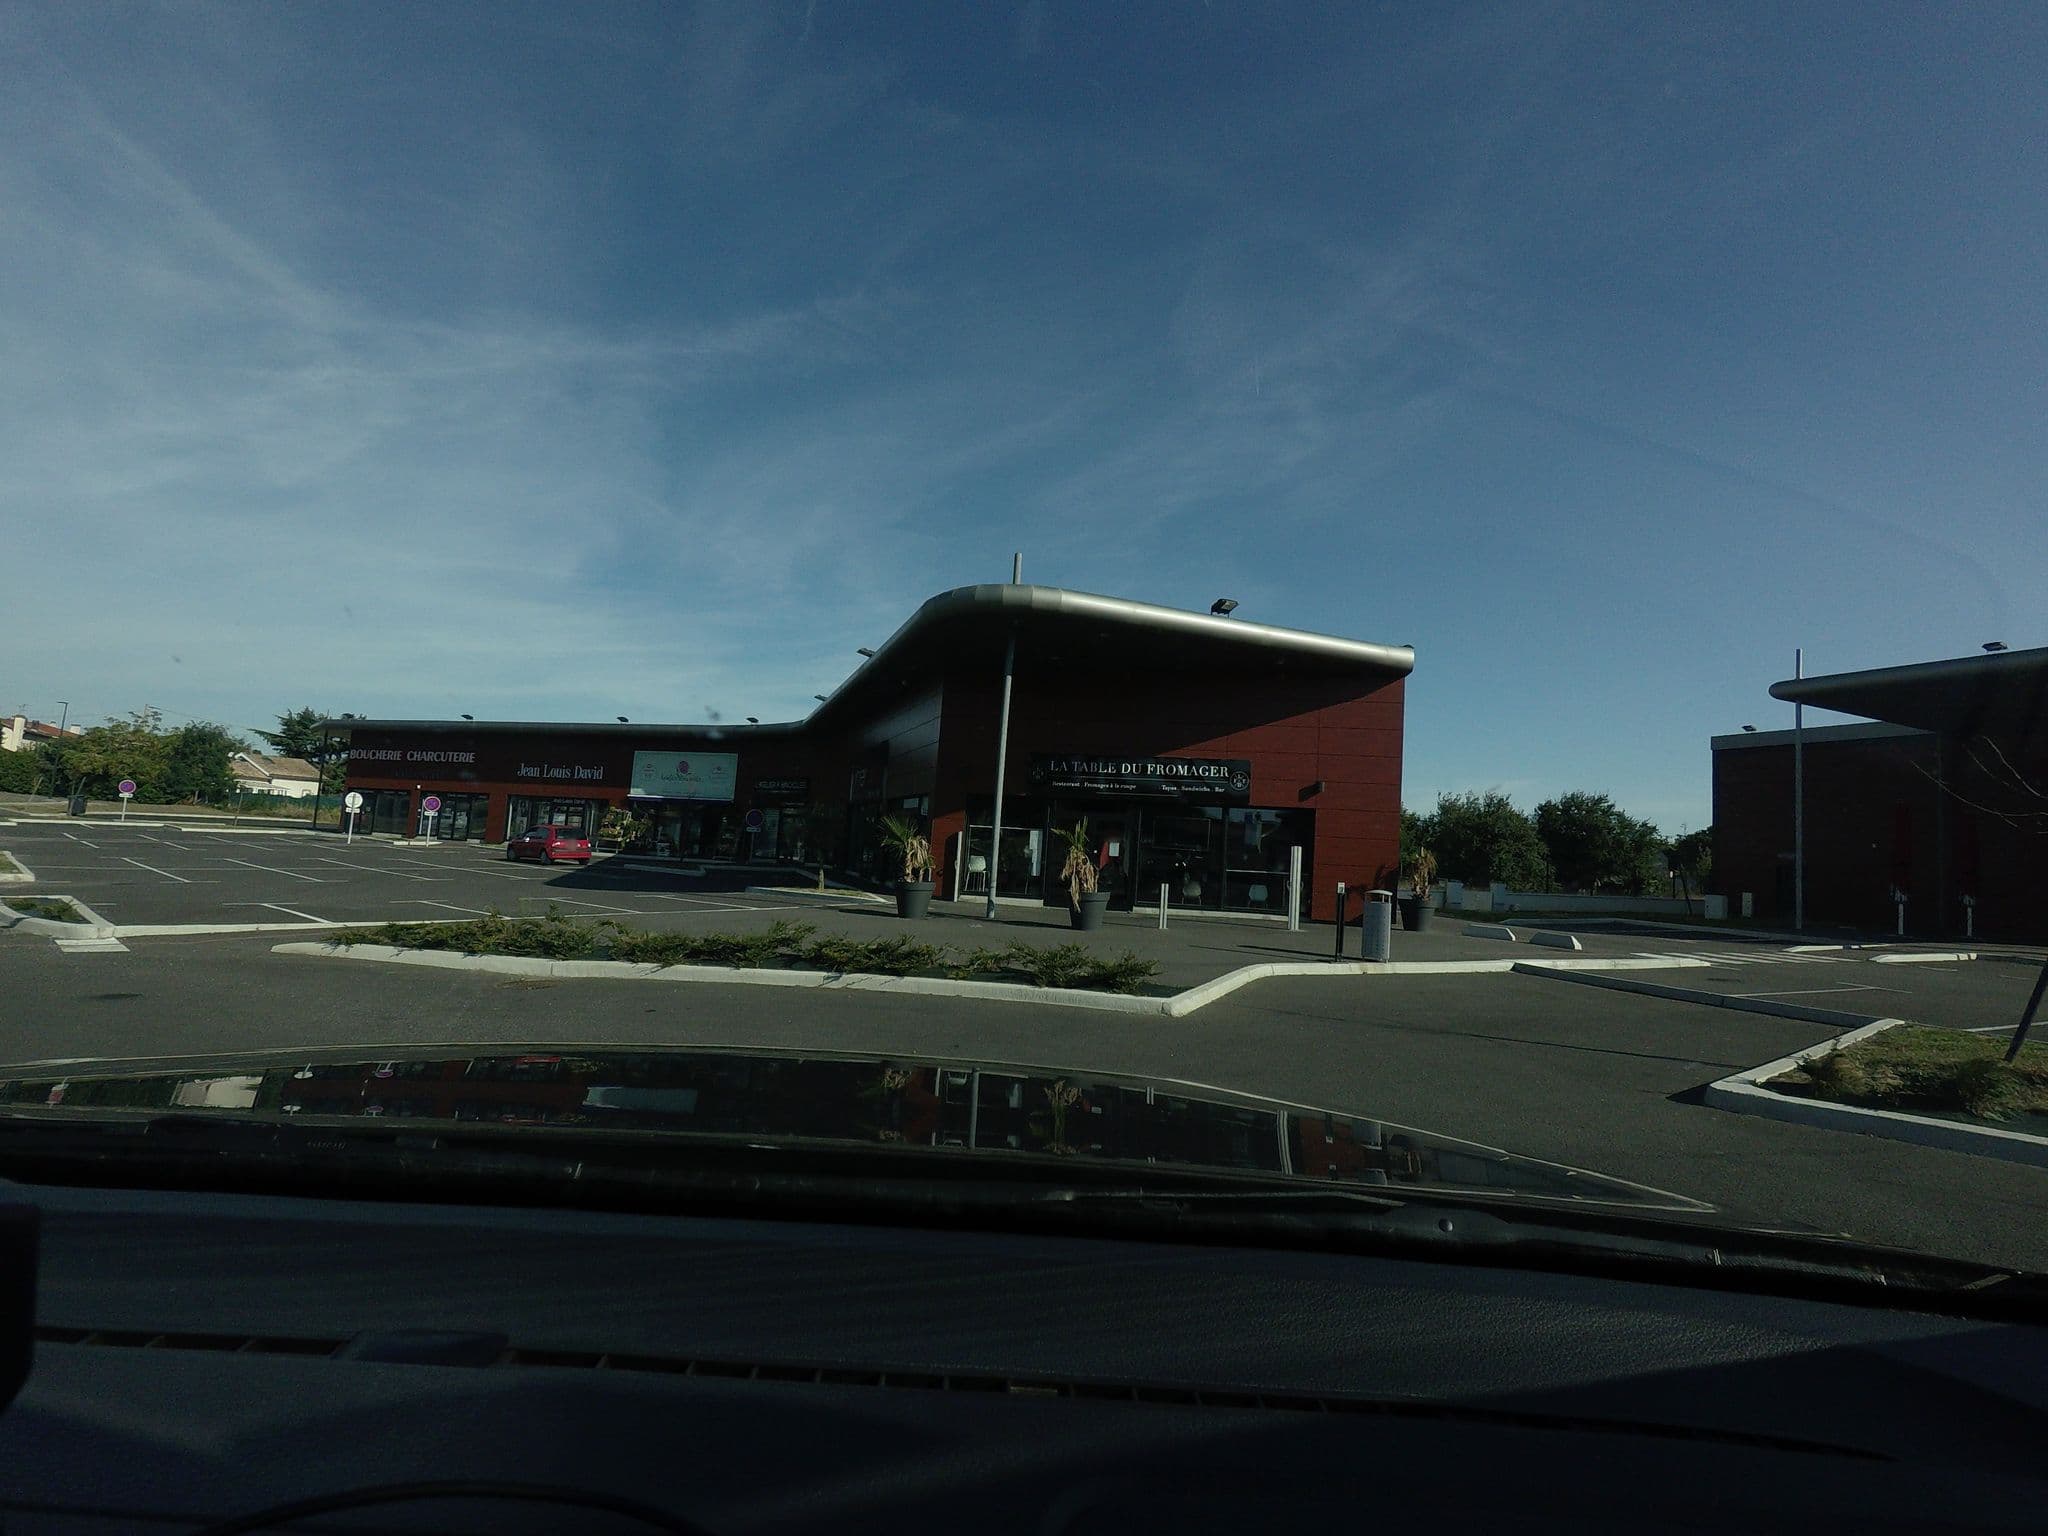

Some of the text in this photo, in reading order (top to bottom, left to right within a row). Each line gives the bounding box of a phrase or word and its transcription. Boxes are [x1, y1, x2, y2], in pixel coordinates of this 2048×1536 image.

[350, 749, 476, 763] BOUCHERIE CHARCUTERIE
[517, 763, 603, 780] Jean Louis David
[1049, 760, 1230, 778] LA TABLE DU FROMAGER
